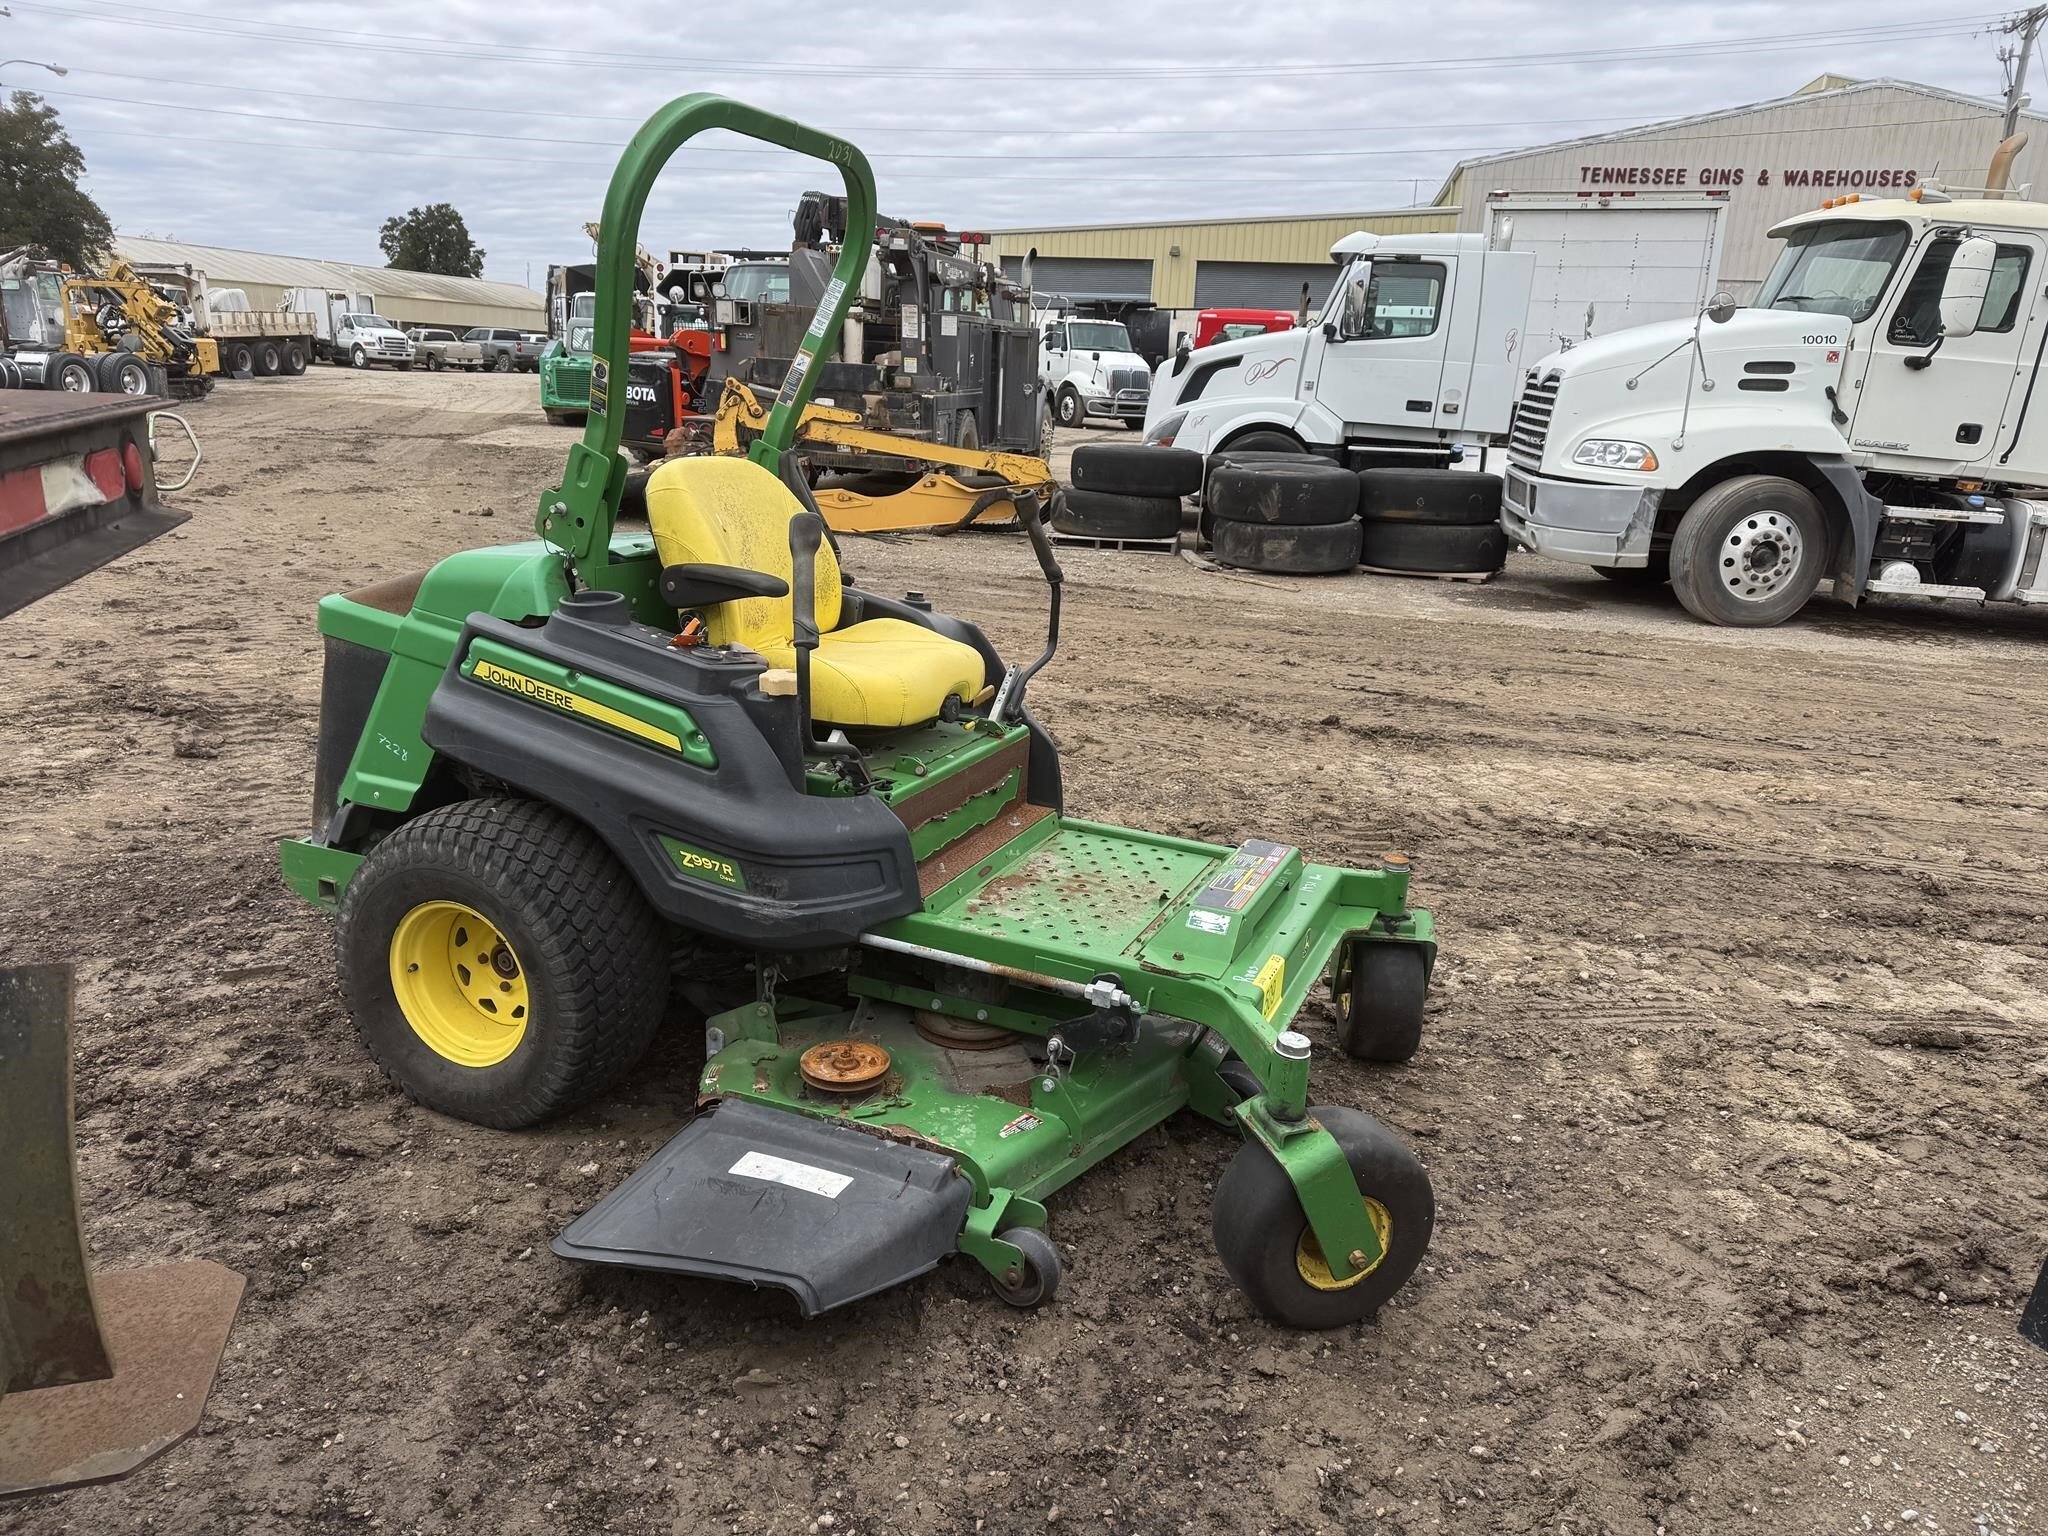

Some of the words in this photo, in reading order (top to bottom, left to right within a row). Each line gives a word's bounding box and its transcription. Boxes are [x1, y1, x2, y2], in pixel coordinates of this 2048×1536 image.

[1580, 166, 1688, 186] TENNESSEE
[1699, 168, 1744, 186] GINS
[1757, 169, 1770, 186] &
[1783, 169, 1917, 188] WAREHOUSES
[1801, 334, 1838, 345] 10010
[626, 385, 657, 402] BOTA
[1854, 438, 1910, 451] MACK
[483, 665, 522, 694] JOHN
[524, 679, 575, 710] DEERE
[679, 850, 720, 872] Z997
[721, 863, 734, 877] R
